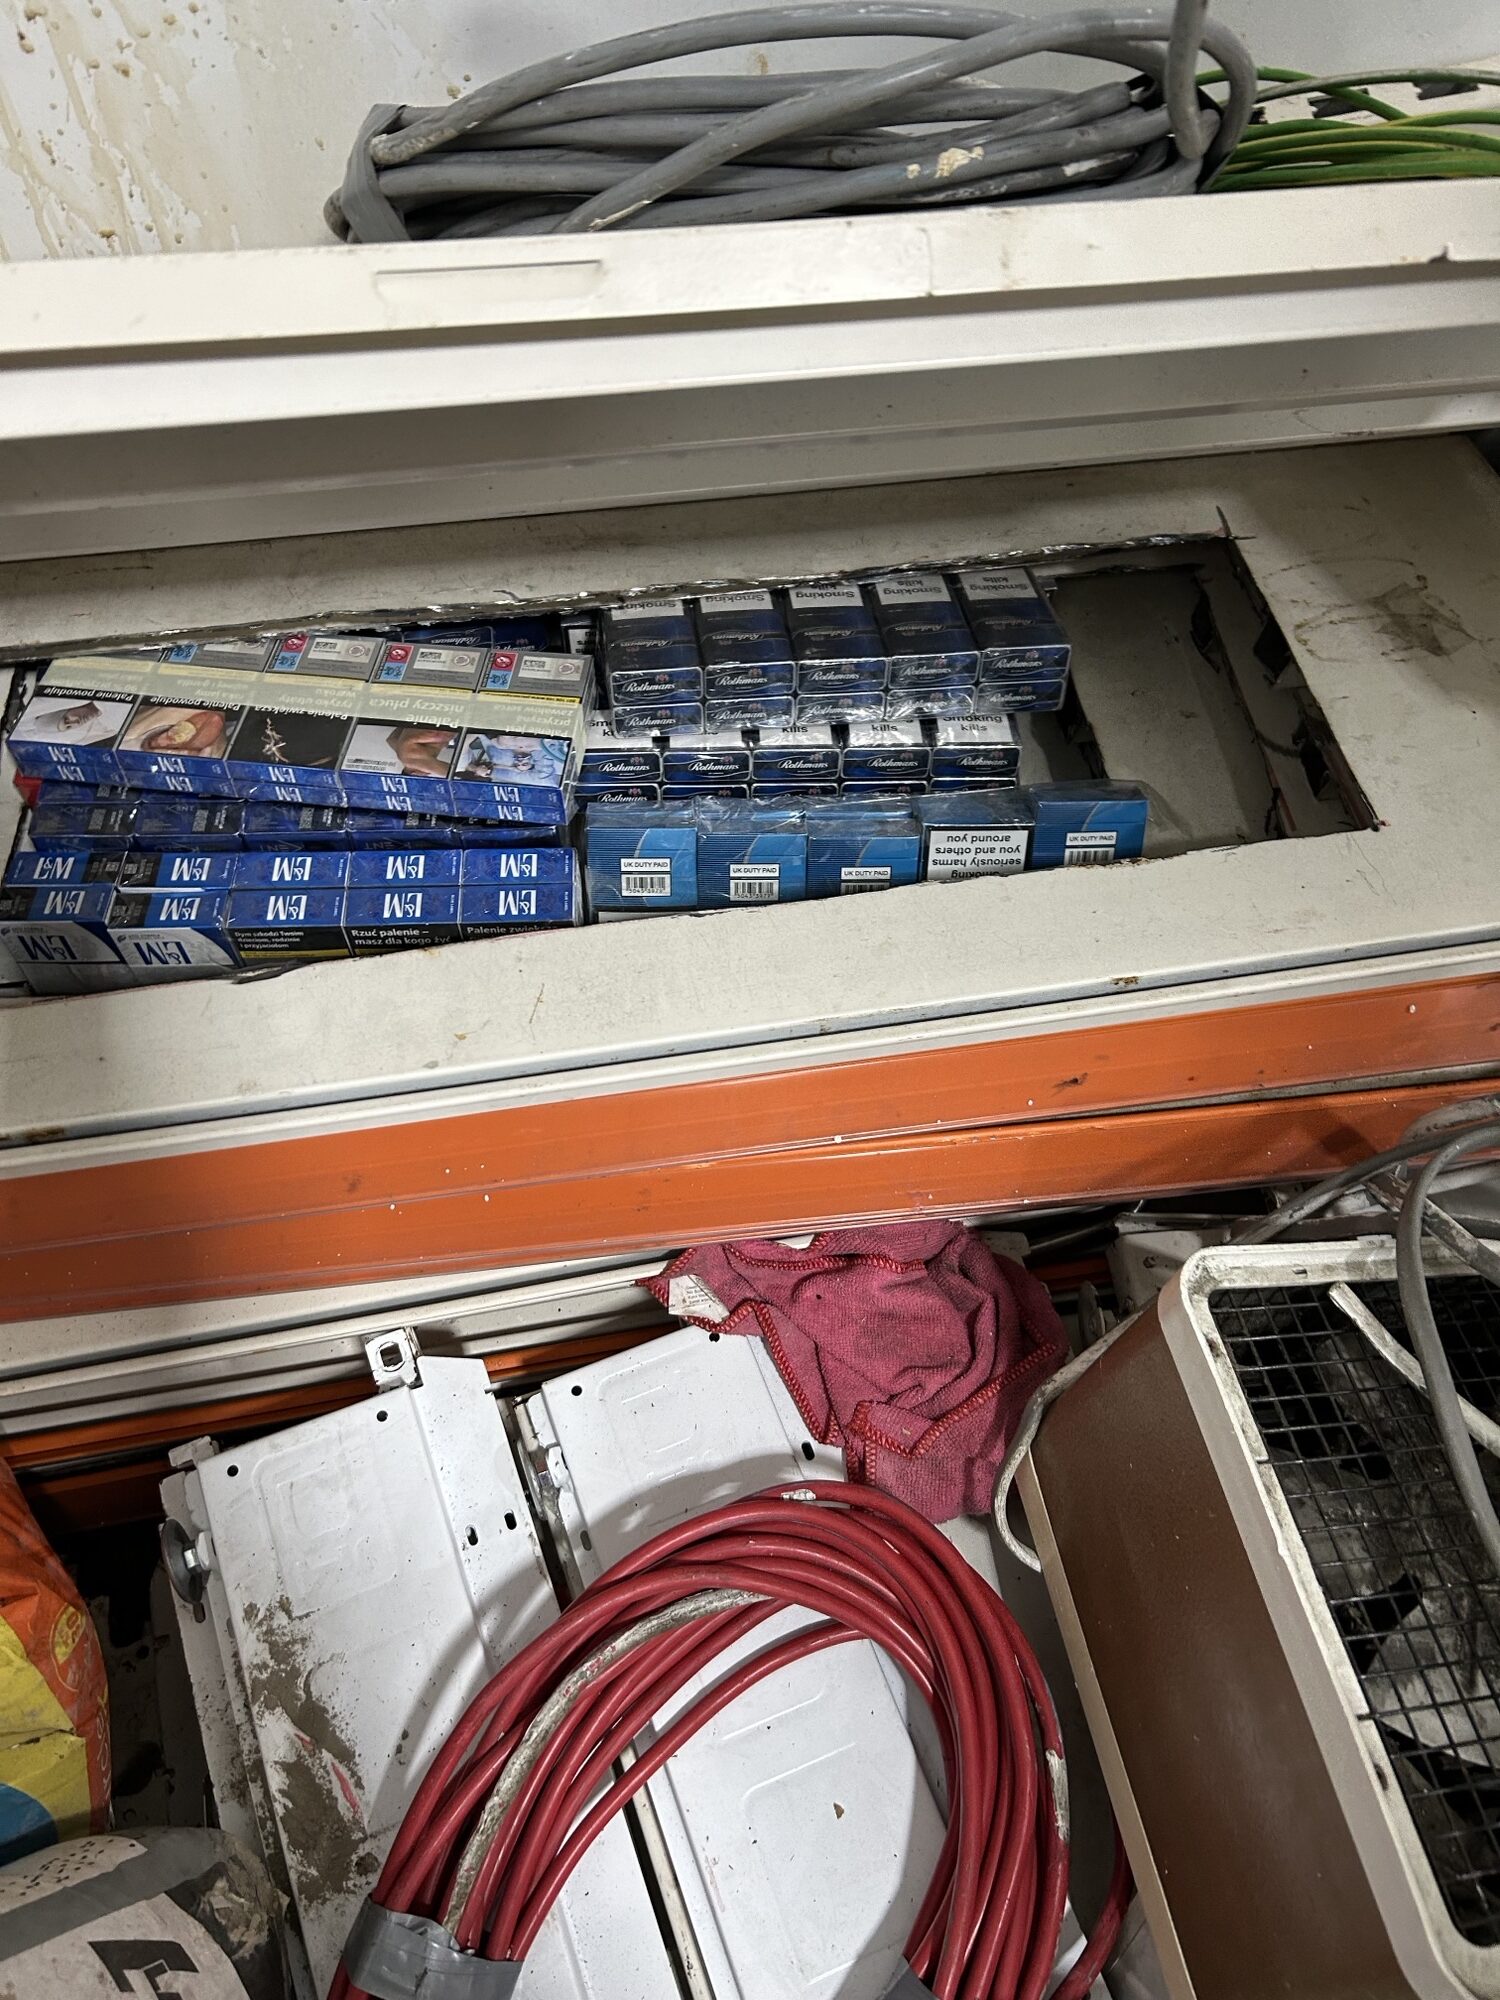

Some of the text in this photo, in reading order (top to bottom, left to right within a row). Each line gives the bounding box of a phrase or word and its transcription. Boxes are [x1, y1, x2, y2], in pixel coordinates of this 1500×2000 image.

[883, 586, 943, 596] Smoking
[969, 582, 1029, 591] Smoking
[705, 593, 765, 603] Smoking
[796, 590, 856, 600] Smoking
[624, 600, 676, 610] Smokin
[901, 664, 951, 676] Rothmans
[991, 658, 1043, 670] Rothmans
[716, 674, 768, 687] Rothmans
[808, 670, 860, 682] Rothmans
[44, 686, 133, 702] Palenie powoduje
[623, 680, 676, 694] Rothmans
[150, 695, 242, 711] Palenie powoduje
[369, 697, 465, 713] niszczy płuca
[306, 709, 348, 720] Palenie
[404, 713, 460, 729] Palenie
[625, 715, 677, 728] Rothmans
[961, 724, 988, 732] kills
[48, 746, 77, 764] L&M
[866, 757, 919, 768] Rothmans
[956, 755, 1008, 767] Rothmans
[157, 756, 186, 774] L&M
[599, 762, 650, 772] Rothmans
[688, 761, 740, 772] Rothmans
[778, 759, 829, 770] Rothmans
[56, 765, 85, 782] L&M
[268, 766, 298, 784] L&M
[165, 775, 194, 793] L&M
[381, 776, 408, 794] L&M
[276, 785, 303, 803] L&M
[493, 786, 520, 803] L&M
[386, 795, 413, 813] L&M
[498, 805, 524, 822] L&M
[946, 835, 1011, 843] around you
[935, 845, 1021, 854] you and others
[33, 856, 75, 880] L&M
[170, 857, 212, 881] L&M
[272, 856, 312, 881] L&M
[386, 854, 425, 880] L&M
[500, 853, 538, 878] L&M
[932, 858, 1021, 867] seriously harms
[951, 870, 1000, 878] moking
[43, 890, 86, 915] L&M
[159, 896, 201, 922] L&M
[266, 894, 307, 921] L&M
[383, 892, 423, 918] L&M
[498, 889, 537, 916] L&M
[351, 927, 377, 937] Rzuć
[380, 927, 419, 938] palenie
[467, 926, 506, 935] Palenie
[18, 935, 78, 961] L&M
[355, 937, 383, 945] masz
[385, 936, 402, 945] dla
[403, 936, 431, 946] kogo
[132, 941, 192, 965] L&M
